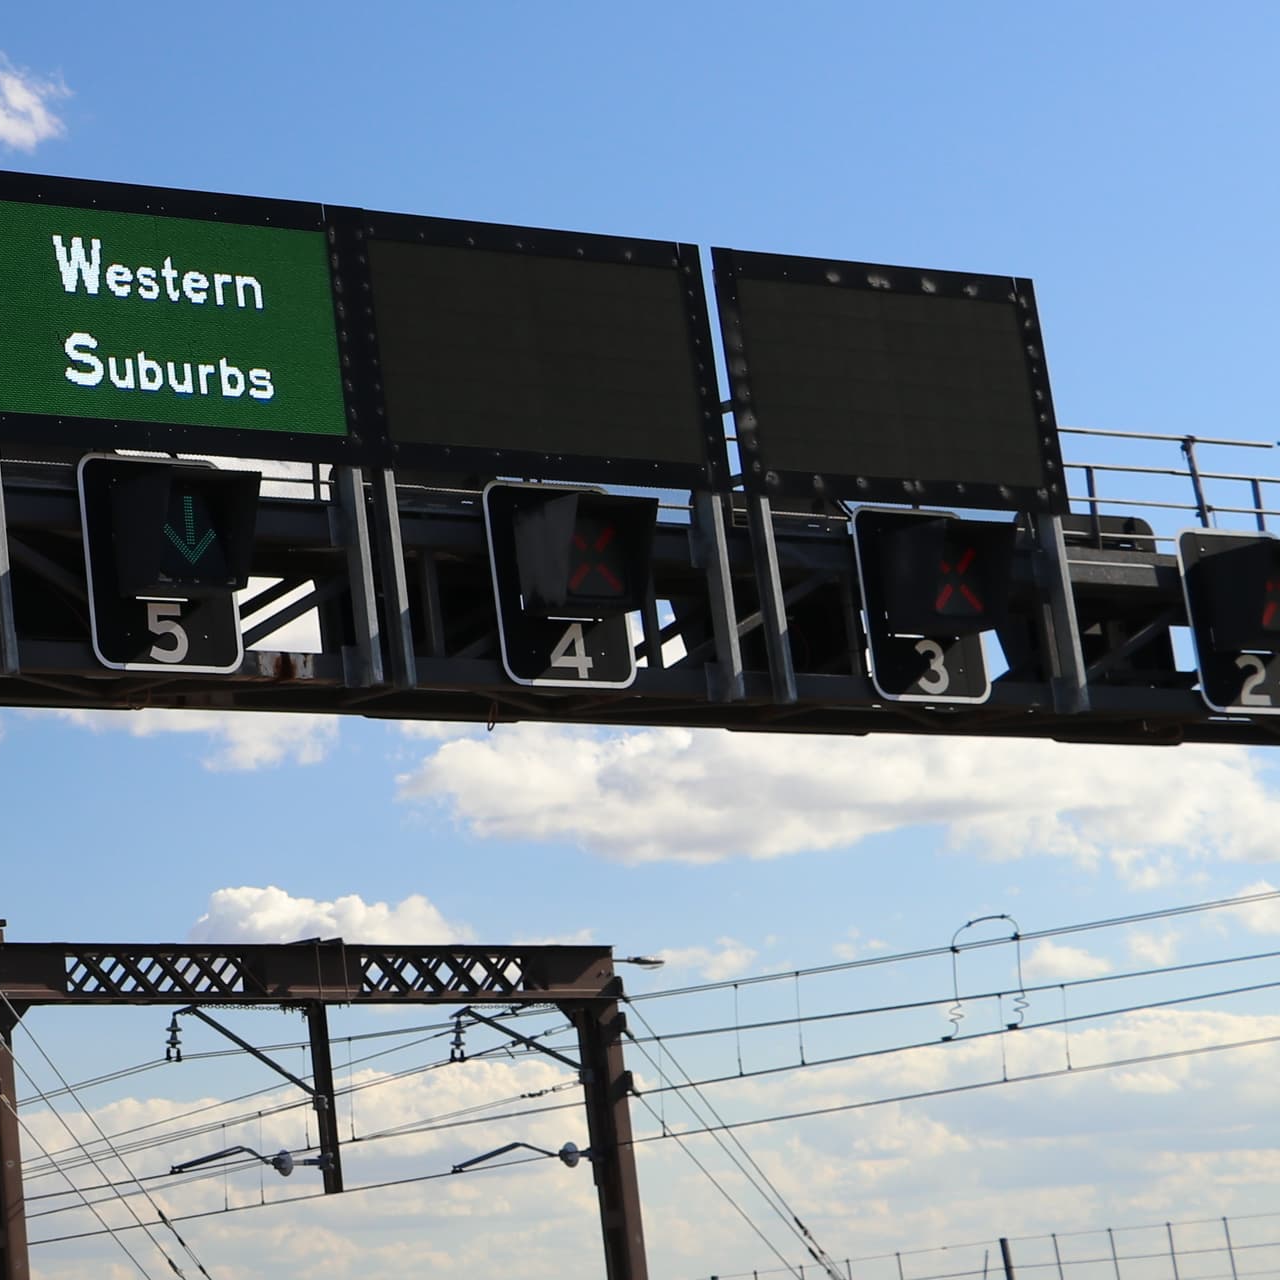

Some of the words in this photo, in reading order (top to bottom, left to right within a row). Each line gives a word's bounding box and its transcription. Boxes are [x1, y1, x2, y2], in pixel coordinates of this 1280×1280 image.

[51, 234, 265, 310] Western
[63, 332, 275, 401] Suburbs
[146, 602, 190, 664] 5
[550, 623, 593, 679] 4
[914, 639, 950, 694] 3
[1234, 654, 1273, 706] 2
